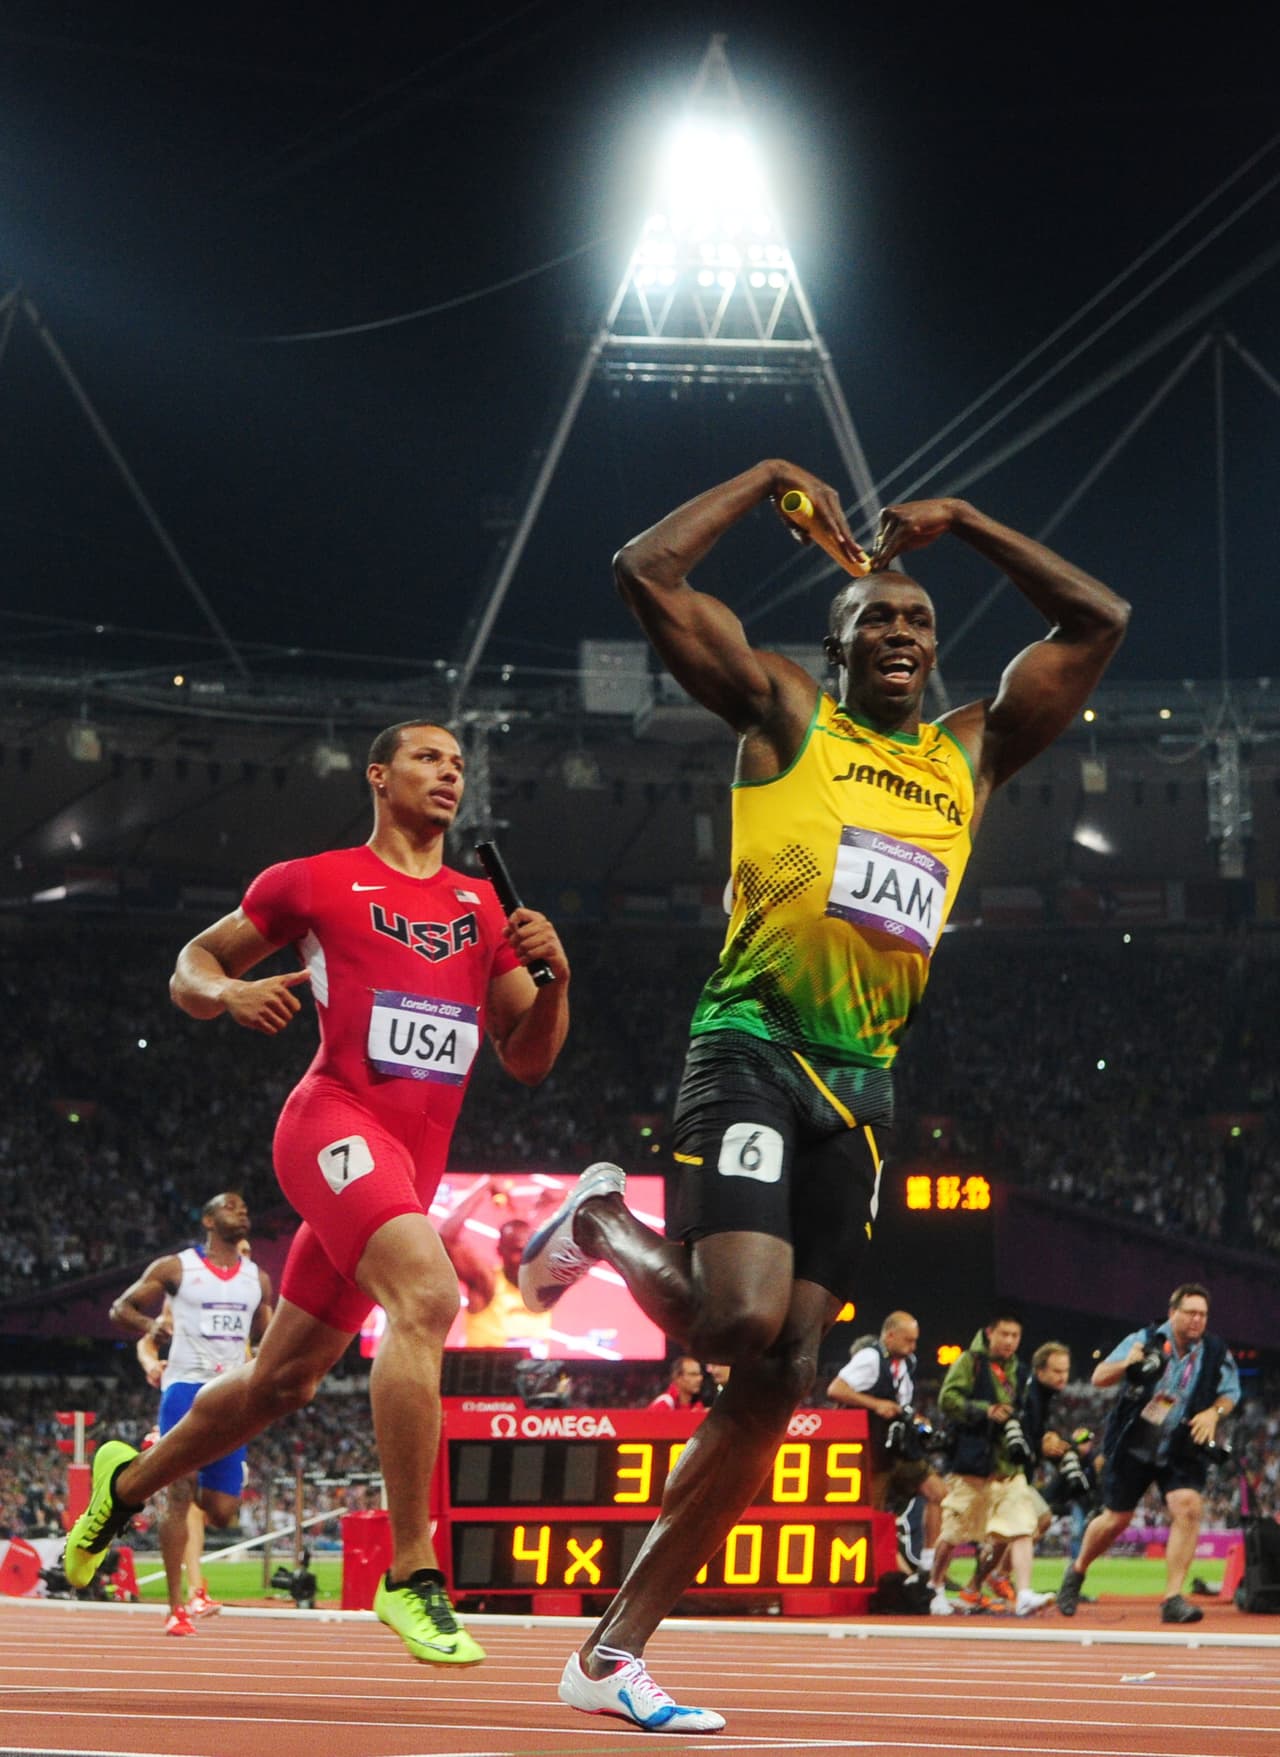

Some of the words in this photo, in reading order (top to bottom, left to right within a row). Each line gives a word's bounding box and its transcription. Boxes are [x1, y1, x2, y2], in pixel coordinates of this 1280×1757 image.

[832, 762, 962, 826] JAMAICA
[872, 837, 912, 862] London
[913, 850, 936, 871] 2012
[851, 861, 934, 928] JAM
[369, 902, 479, 964] USA
[400, 996, 439, 1013] London
[439, 1003, 462, 1018] 2012
[389, 1018, 456, 1065] USA
[330, 1143, 350, 1180] 7
[740, 1130, 762, 1172] 6
[212, 1314, 243, 1332] FRA
[521, 1415, 616, 1438] OMEGA
[696, 1524, 868, 1585] 00M
